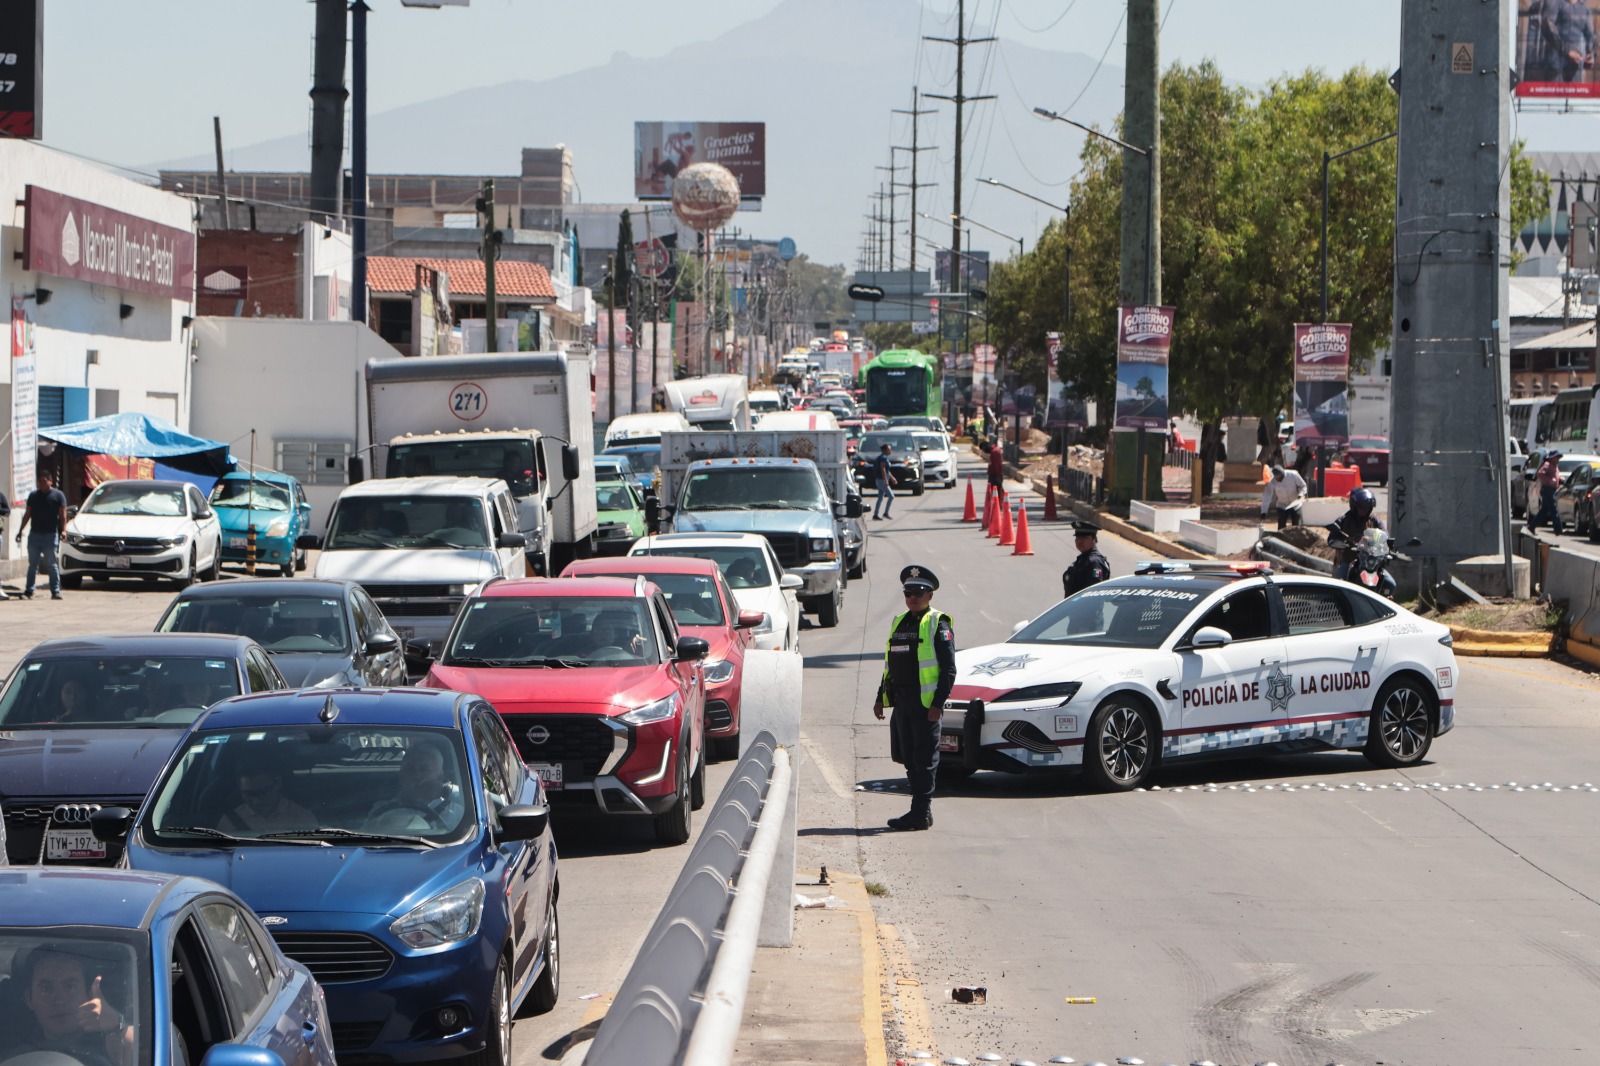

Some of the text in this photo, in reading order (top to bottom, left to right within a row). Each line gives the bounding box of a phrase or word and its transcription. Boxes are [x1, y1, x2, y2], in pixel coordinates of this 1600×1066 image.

[704, 132, 755, 149] Gracias
[82, 213, 174, 287] Nacional Monte de Piedad
[1124, 313, 1169, 328] GOBIERNO
[1125, 323, 1169, 335] DEL ESTADO
[1299, 332, 1347, 348] GOBIERNO
[1301, 343, 1347, 355] DEL ESTADO
[454, 392, 481, 411] 271
[1182, 670, 1371, 709] POLICÍA DE LA CIUDAD
[50, 837, 104, 850] TYW-197-B
[260, 916, 285, 925] Ford
